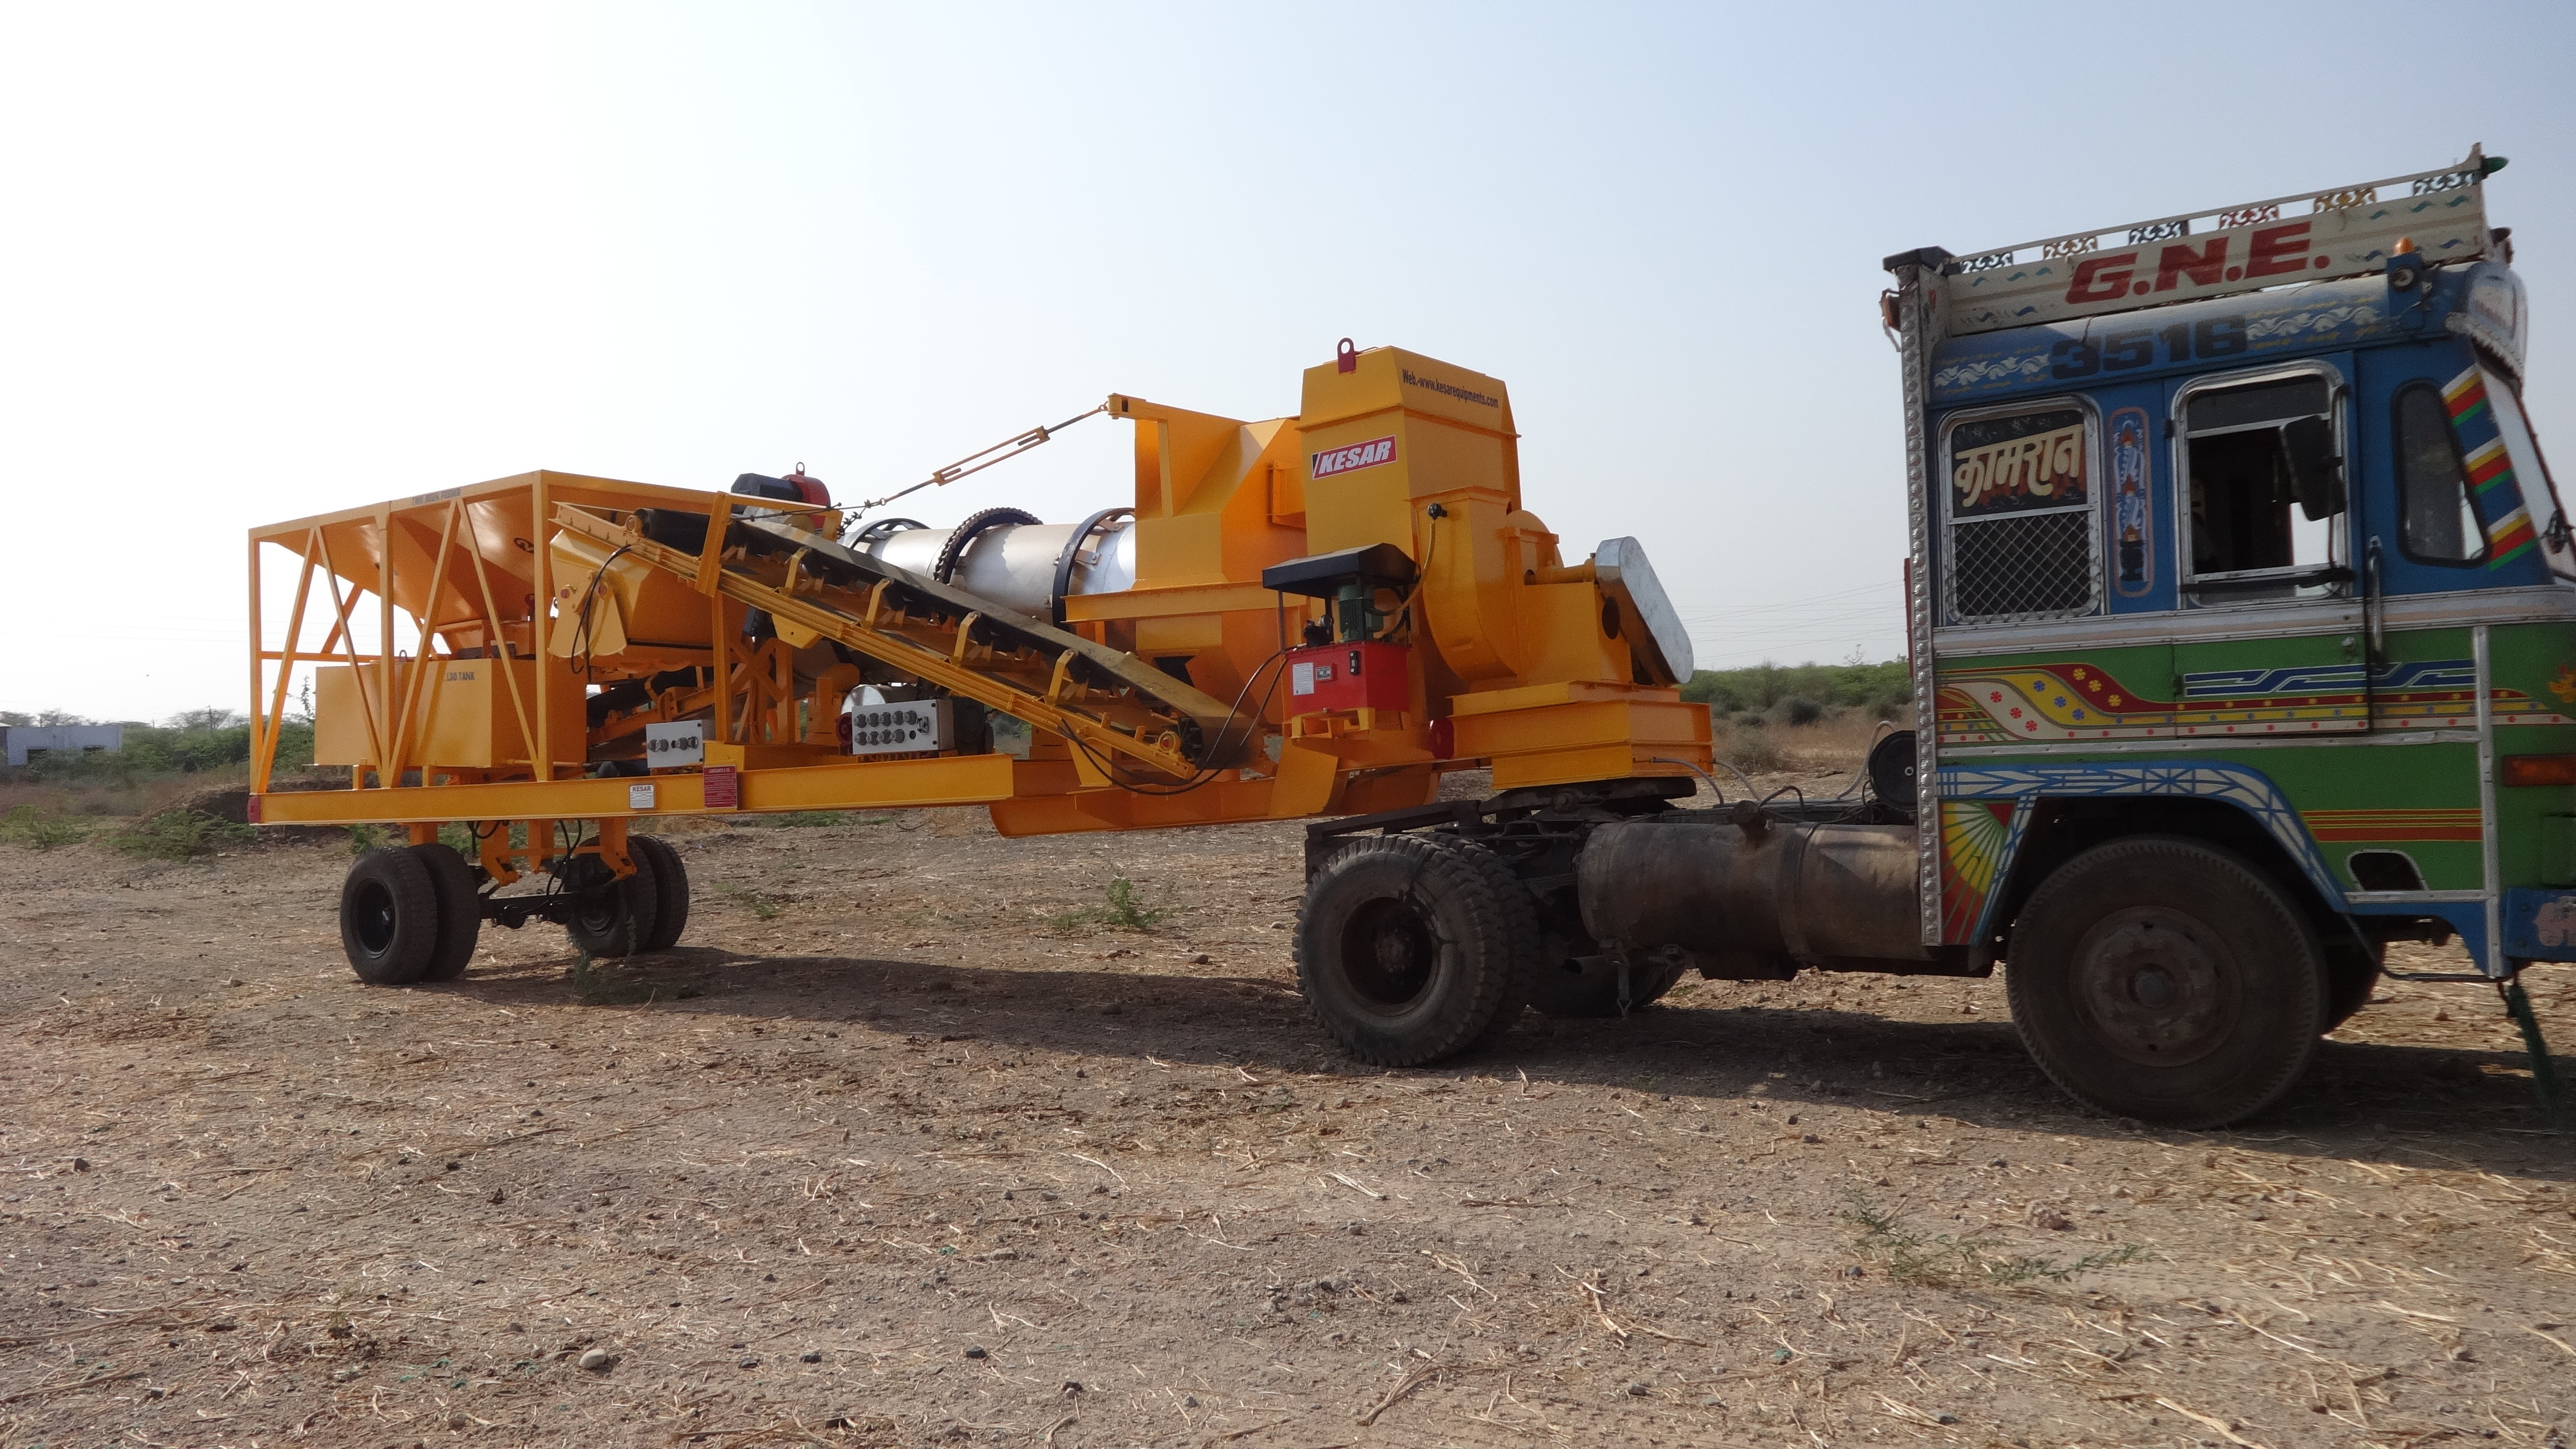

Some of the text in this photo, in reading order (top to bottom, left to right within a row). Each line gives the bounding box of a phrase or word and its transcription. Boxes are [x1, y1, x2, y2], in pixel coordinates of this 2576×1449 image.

[2066, 221, 2331, 305] G.N.E.
[2051, 315, 2246, 380] 3516
[1318, 441, 1392, 475] KESAR
[1953, 423, 2086, 508] कामरान
